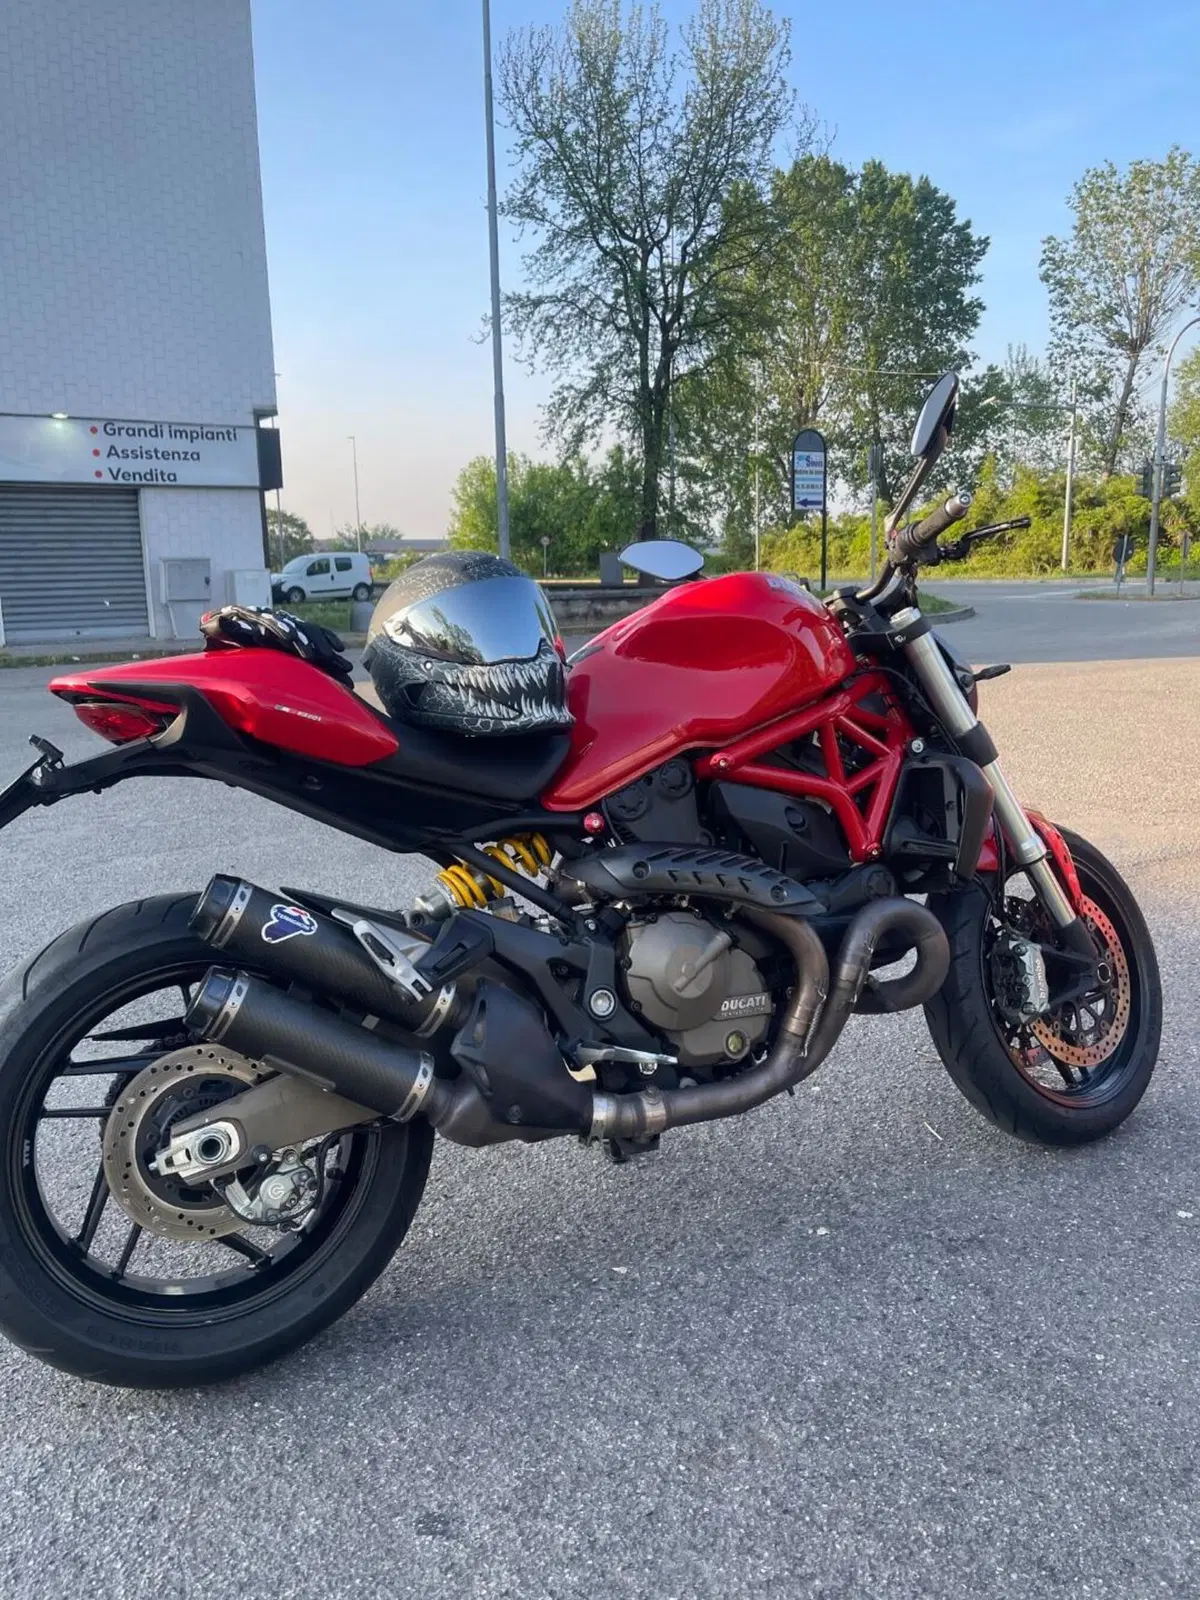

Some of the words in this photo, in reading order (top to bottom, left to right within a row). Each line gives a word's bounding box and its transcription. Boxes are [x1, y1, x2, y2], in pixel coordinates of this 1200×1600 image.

[103, 421, 164, 439] Grandi
[168, 427, 238, 443] impianti
[106, 444, 201, 461] Assistenza
[108, 467, 178, 483] Vendita
[721, 995, 766, 1011] DUCATI
